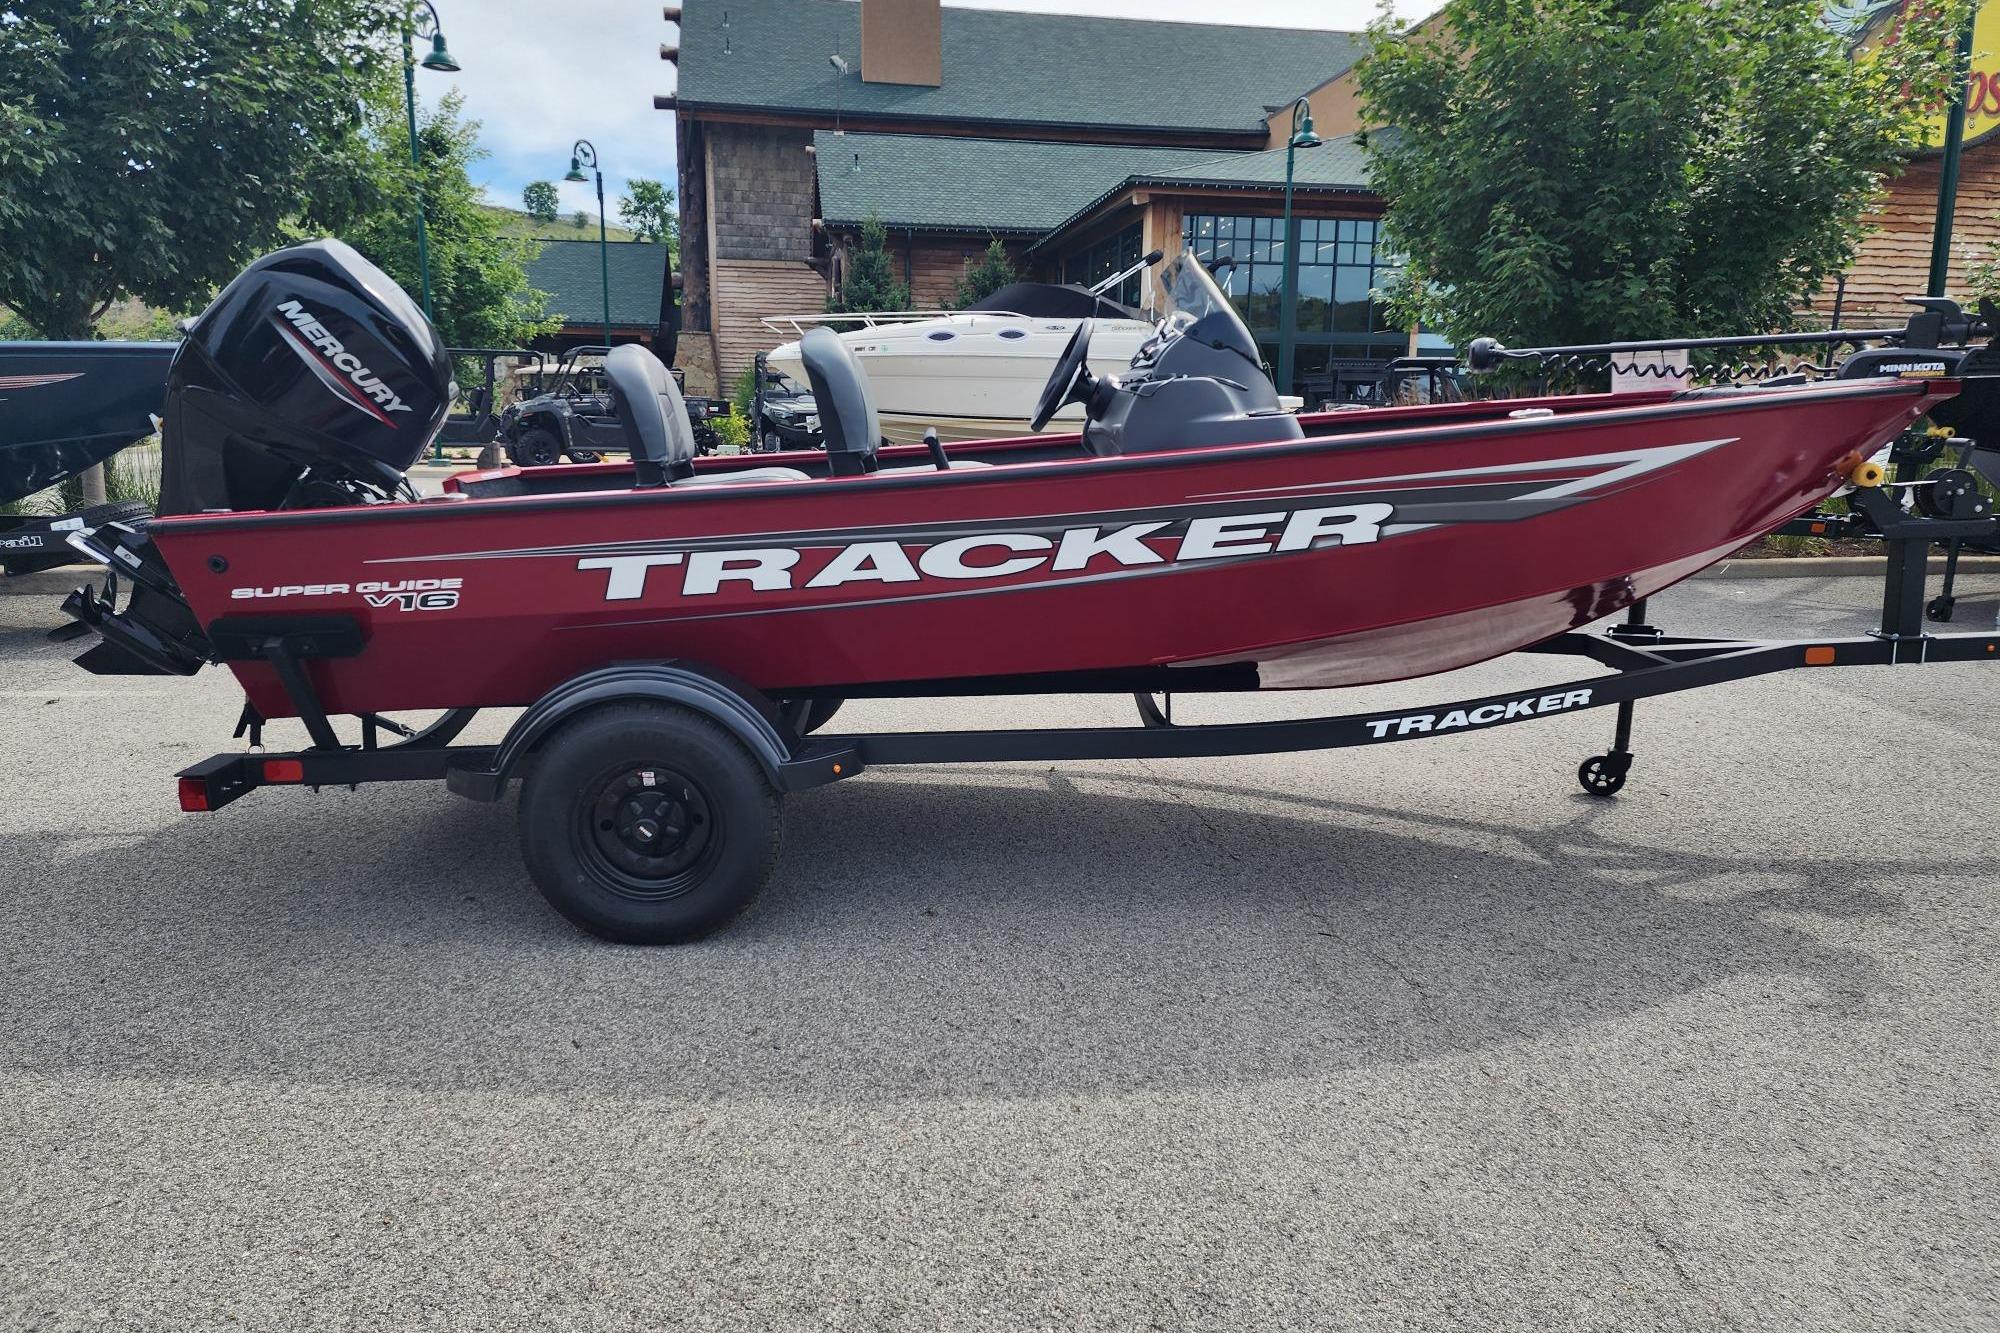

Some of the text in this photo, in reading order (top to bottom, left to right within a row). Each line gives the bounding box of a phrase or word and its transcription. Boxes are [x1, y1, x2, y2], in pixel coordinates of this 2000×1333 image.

[276, 300, 413, 412] MERCURY
[1879, 362, 1946, 373] MINN KOTA
[576, 502, 1395, 600] TRACKER
[231, 577, 464, 599] SUPER GUIDE
[363, 590, 460, 612] V16
[1365, 688, 1593, 738] TRACKER
